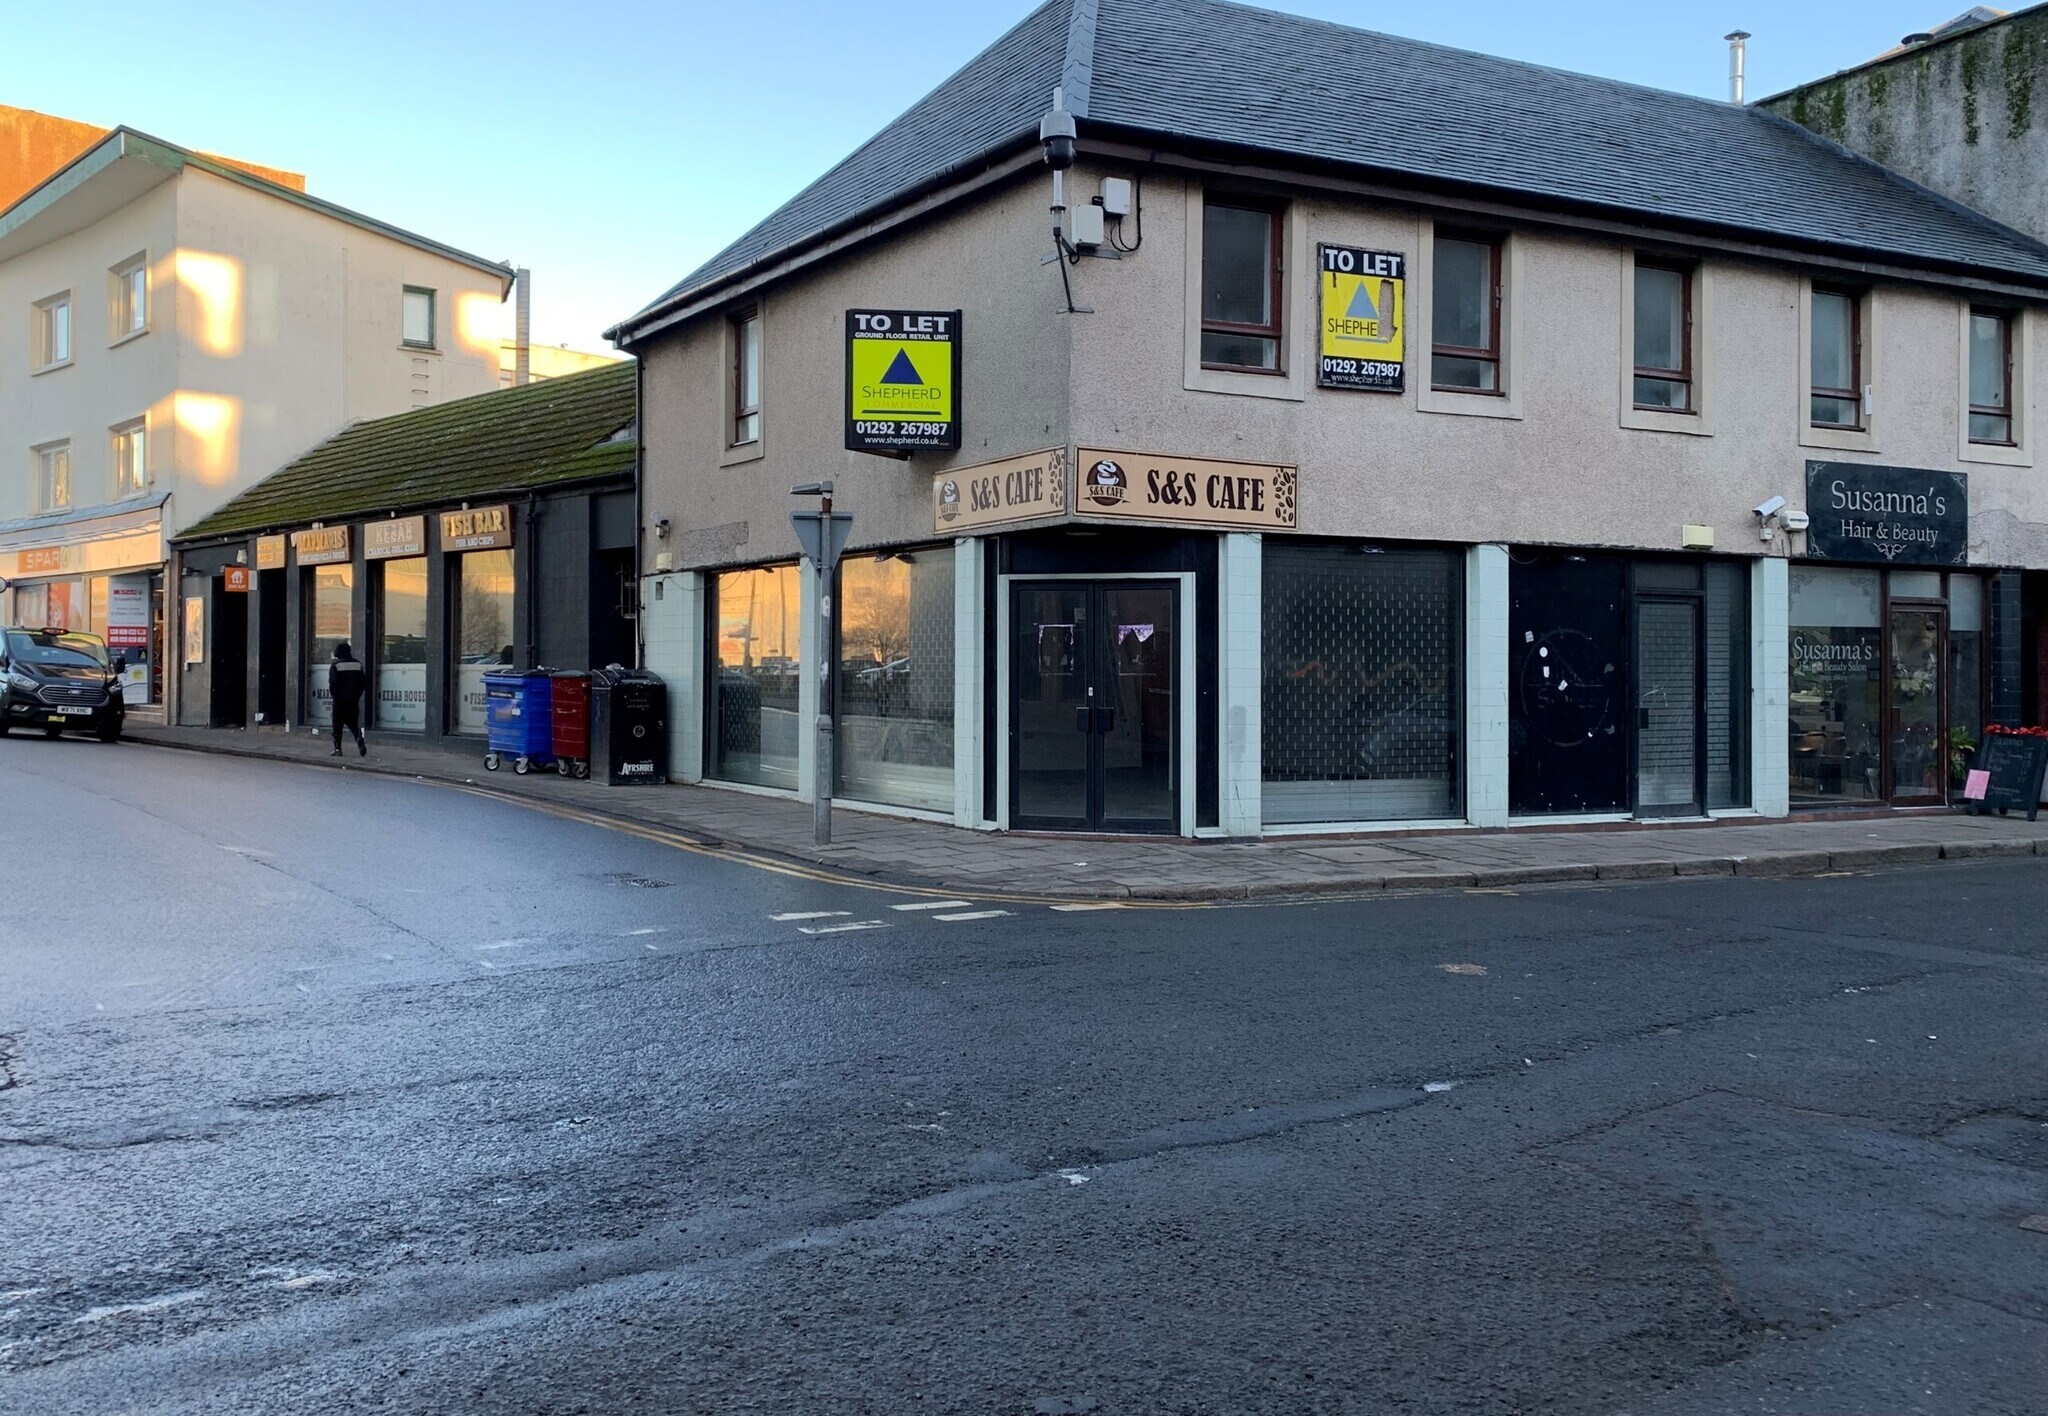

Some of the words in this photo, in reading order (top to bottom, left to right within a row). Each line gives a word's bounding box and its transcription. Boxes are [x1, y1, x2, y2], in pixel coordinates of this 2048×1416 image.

[1325, 249, 1354, 272] TO
[1363, 254, 1400, 276] LET
[855, 314, 891, 330] TO
[903, 316, 949, 332] LET
[1328, 318, 1378, 336] SHEPHE
[1324, 358, 1356, 374] 01292
[1361, 362, 1400, 377] 267987
[862, 386, 941, 400] SHEPHERD
[867, 401, 936, 409] COMMERCIAL
[856, 422, 895, 434] 01292
[900, 422, 947, 435] 267987
[864, 436, 939, 446] www.shepherd.co.uk
[971, 474, 1000, 512] S&S
[1006, 467, 1043, 506] CAFE
[1089, 485, 1105, 497] S&S
[1106, 486, 1124, 498] CAFE
[1147, 470, 1196, 506] S&S
[1206, 474, 1264, 511] CAFE
[1832, 480, 1946, 516] Susanna's
[443, 516, 474, 537] FISH
[476, 510, 504, 534] BAR
[376, 522, 413, 544] KEBAB
[1841, 519, 1872, 538] Hair
[1876, 522, 1888, 539] &
[1893, 523, 1938, 548] Beauty
[26, 551, 60, 568] SPAR
[1794, 637, 1872, 660] Susanna's
[1848, 660, 1866, 671] Salon
[382, 691, 402, 701] KEBAB
[404, 691, 425, 702] HOUSE
[622, 762, 654, 775] AYRSHIRE
